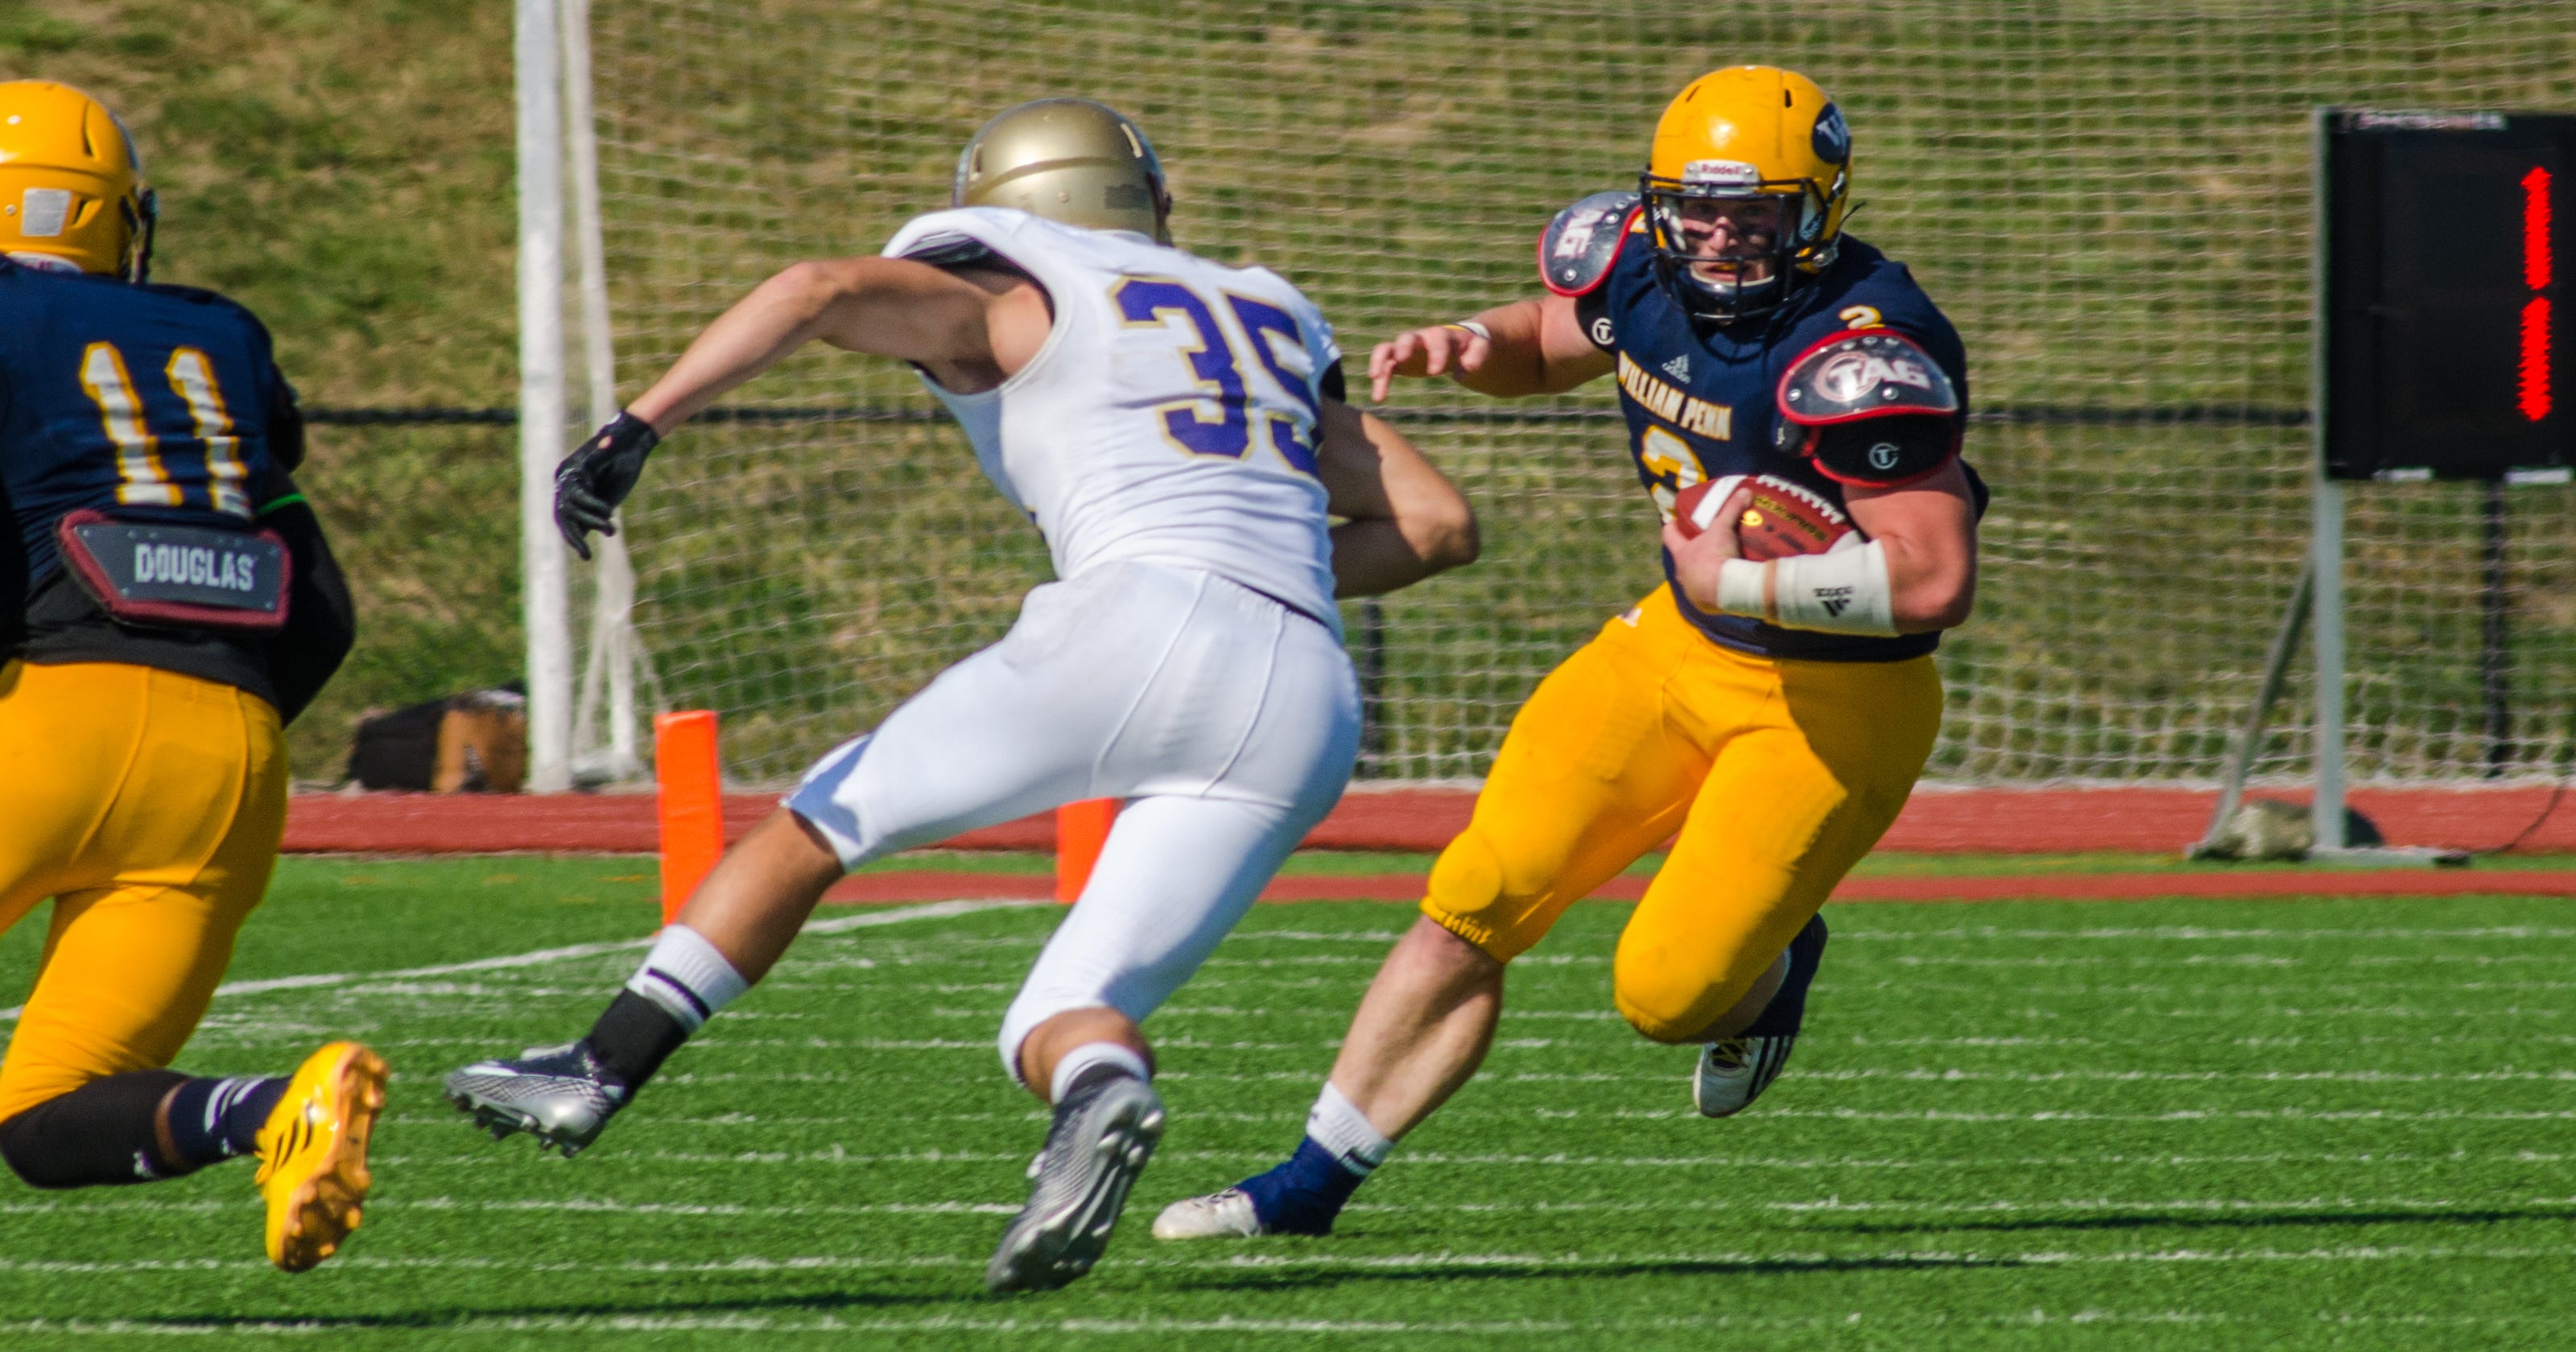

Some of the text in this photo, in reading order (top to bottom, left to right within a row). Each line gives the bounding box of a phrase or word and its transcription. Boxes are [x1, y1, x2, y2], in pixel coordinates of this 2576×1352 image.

[1700, 163, 1742, 175] Riddell
[1839, 305, 1885, 330] 2
[2517, 166, 2553, 421] 1
[1108, 274, 1323, 478] 35
[1618, 349, 1733, 442] WILLIAM PENN
[79, 340, 256, 520] 11
[134, 542, 255, 592] DOUGLAS
